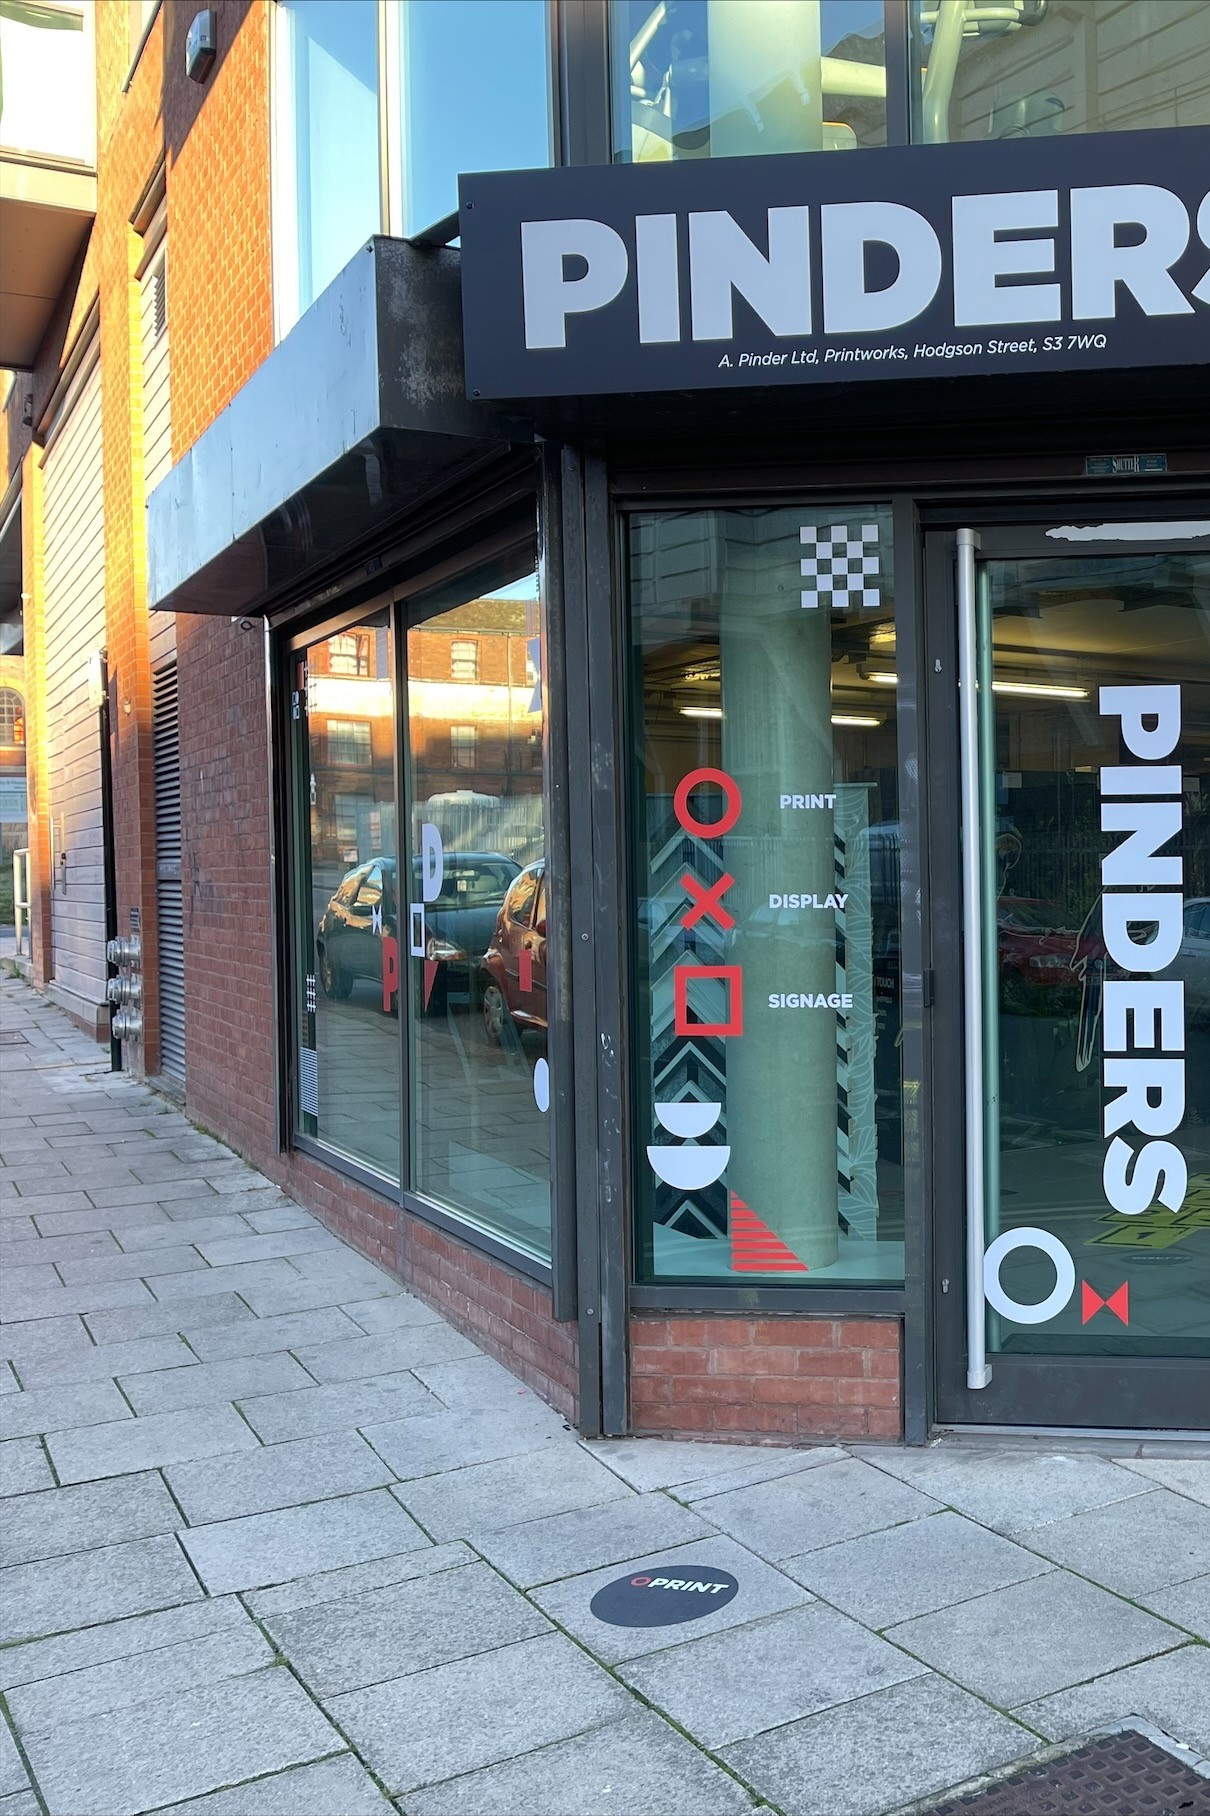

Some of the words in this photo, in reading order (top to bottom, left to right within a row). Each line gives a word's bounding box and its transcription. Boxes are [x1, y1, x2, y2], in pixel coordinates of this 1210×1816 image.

[718, 354, 733, 368] A.
[738, 351, 788, 367] Pinder
[791, 349, 819, 365] Ltd,
[824, 345, 908, 363] Printworks,
[913, 342, 983, 359] Hodgson
[987, 338, 1037, 354] Street,
[1042, 336, 1063, 351] S3
[1067, 333, 1107, 349] 7WQ
[779, 794, 837, 809] PRINT
[769, 894, 849, 911] DISPLAY
[1099, 684, 1188, 1215] PINDERS
[768, 993, 853, 1010] SIGNAGE
[647, 1577, 729, 1594] PRINT
